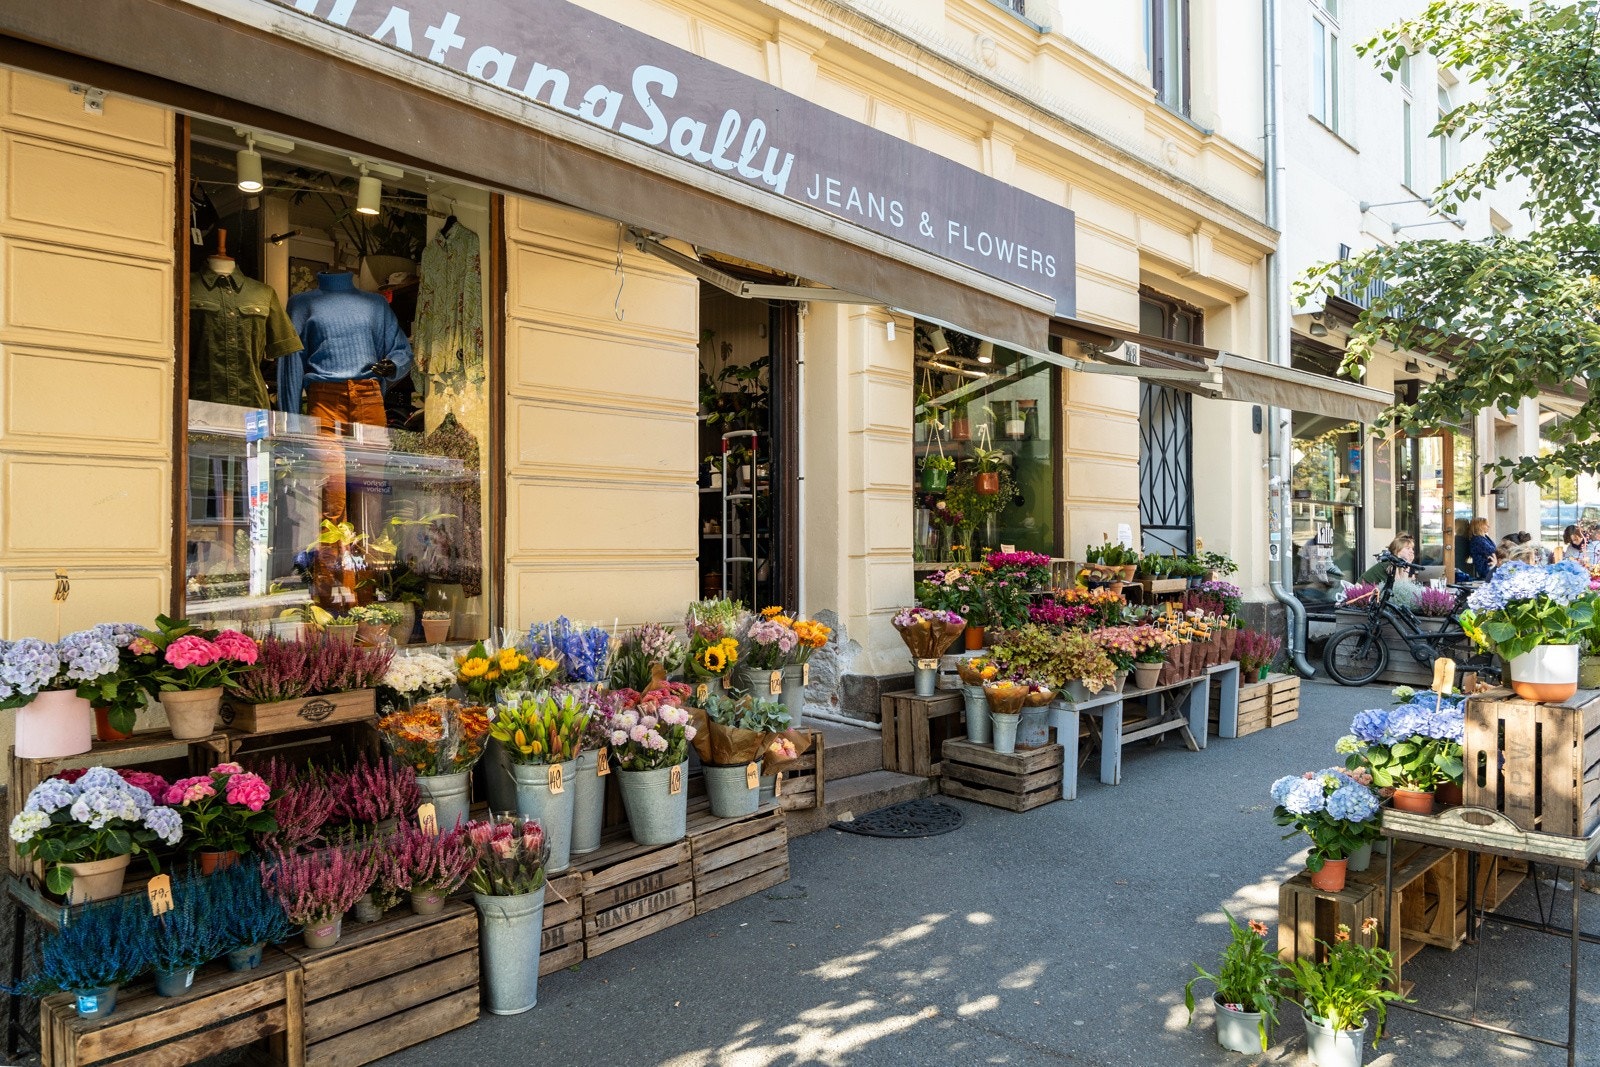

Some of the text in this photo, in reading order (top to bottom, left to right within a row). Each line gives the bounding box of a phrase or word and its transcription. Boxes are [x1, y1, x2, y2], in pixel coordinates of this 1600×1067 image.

[806, 173, 905, 228] JEANS
[919, 211, 935, 238] &
[948, 220, 1056, 278] FLOWERS
